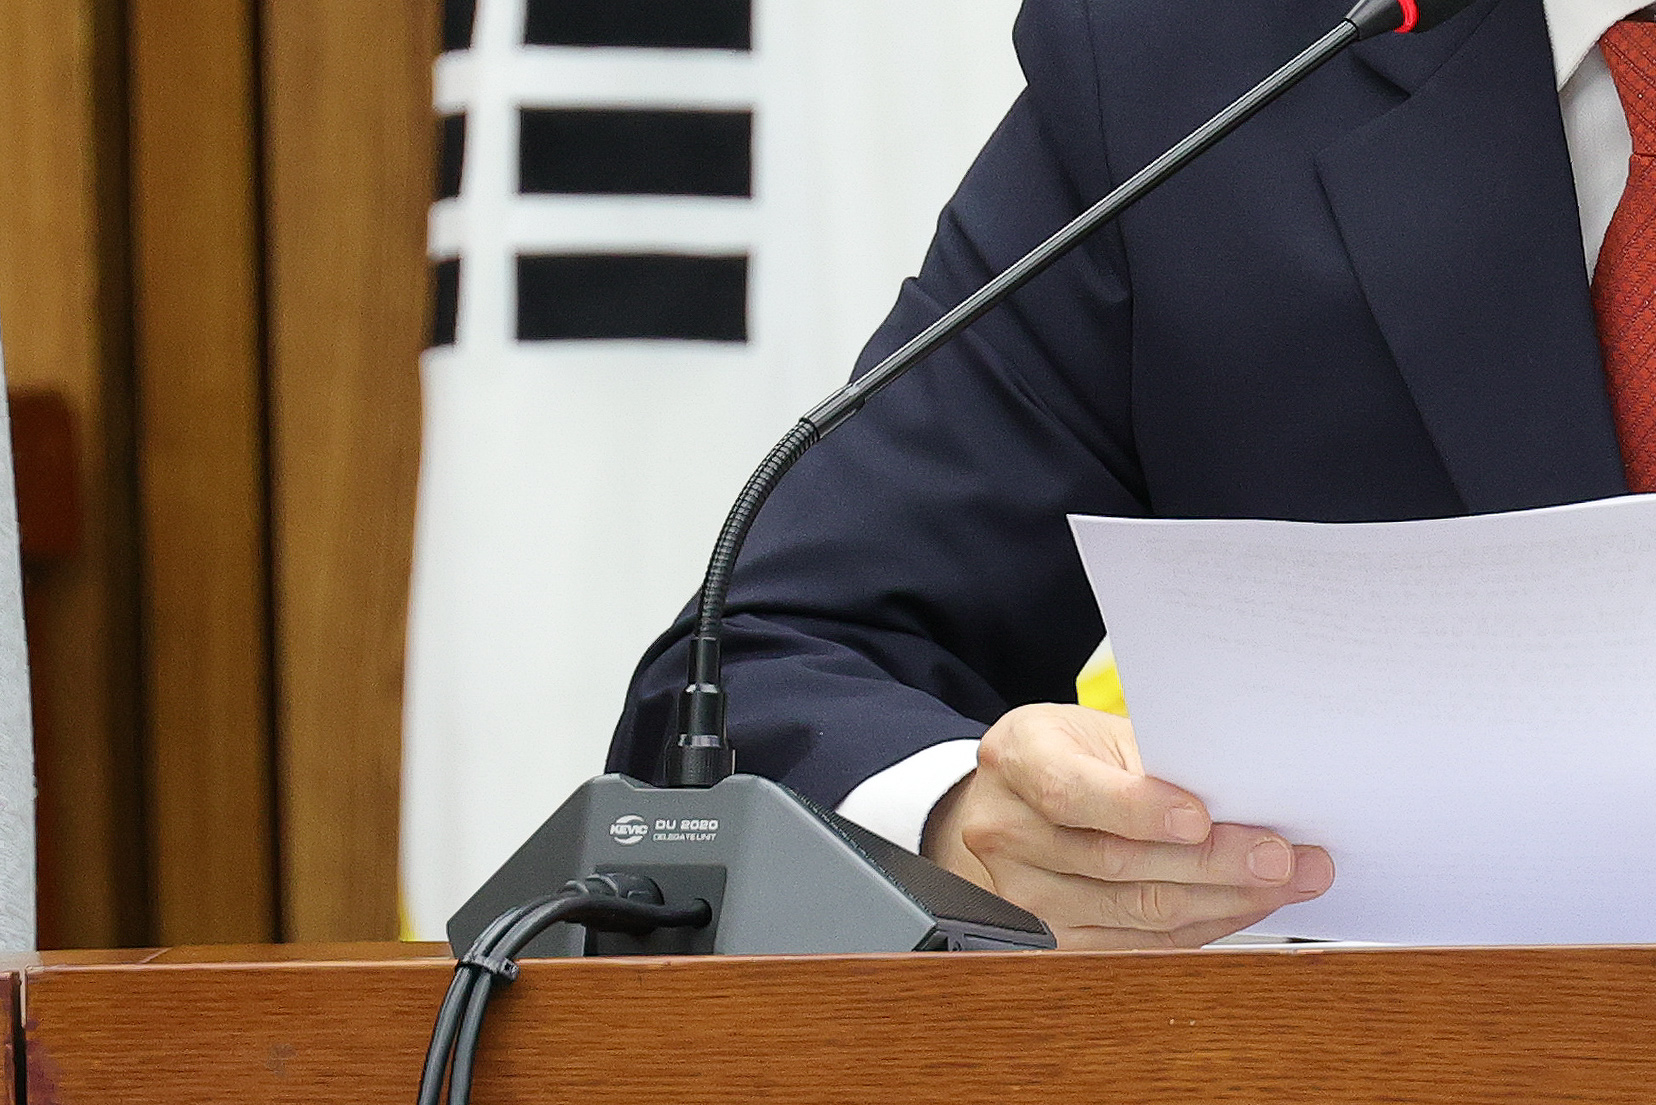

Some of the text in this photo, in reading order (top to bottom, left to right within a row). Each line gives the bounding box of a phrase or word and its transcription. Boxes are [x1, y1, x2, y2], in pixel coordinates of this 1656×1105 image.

[609, 824, 649, 835] KEVIC
[654, 819, 719, 830] DU 2020
